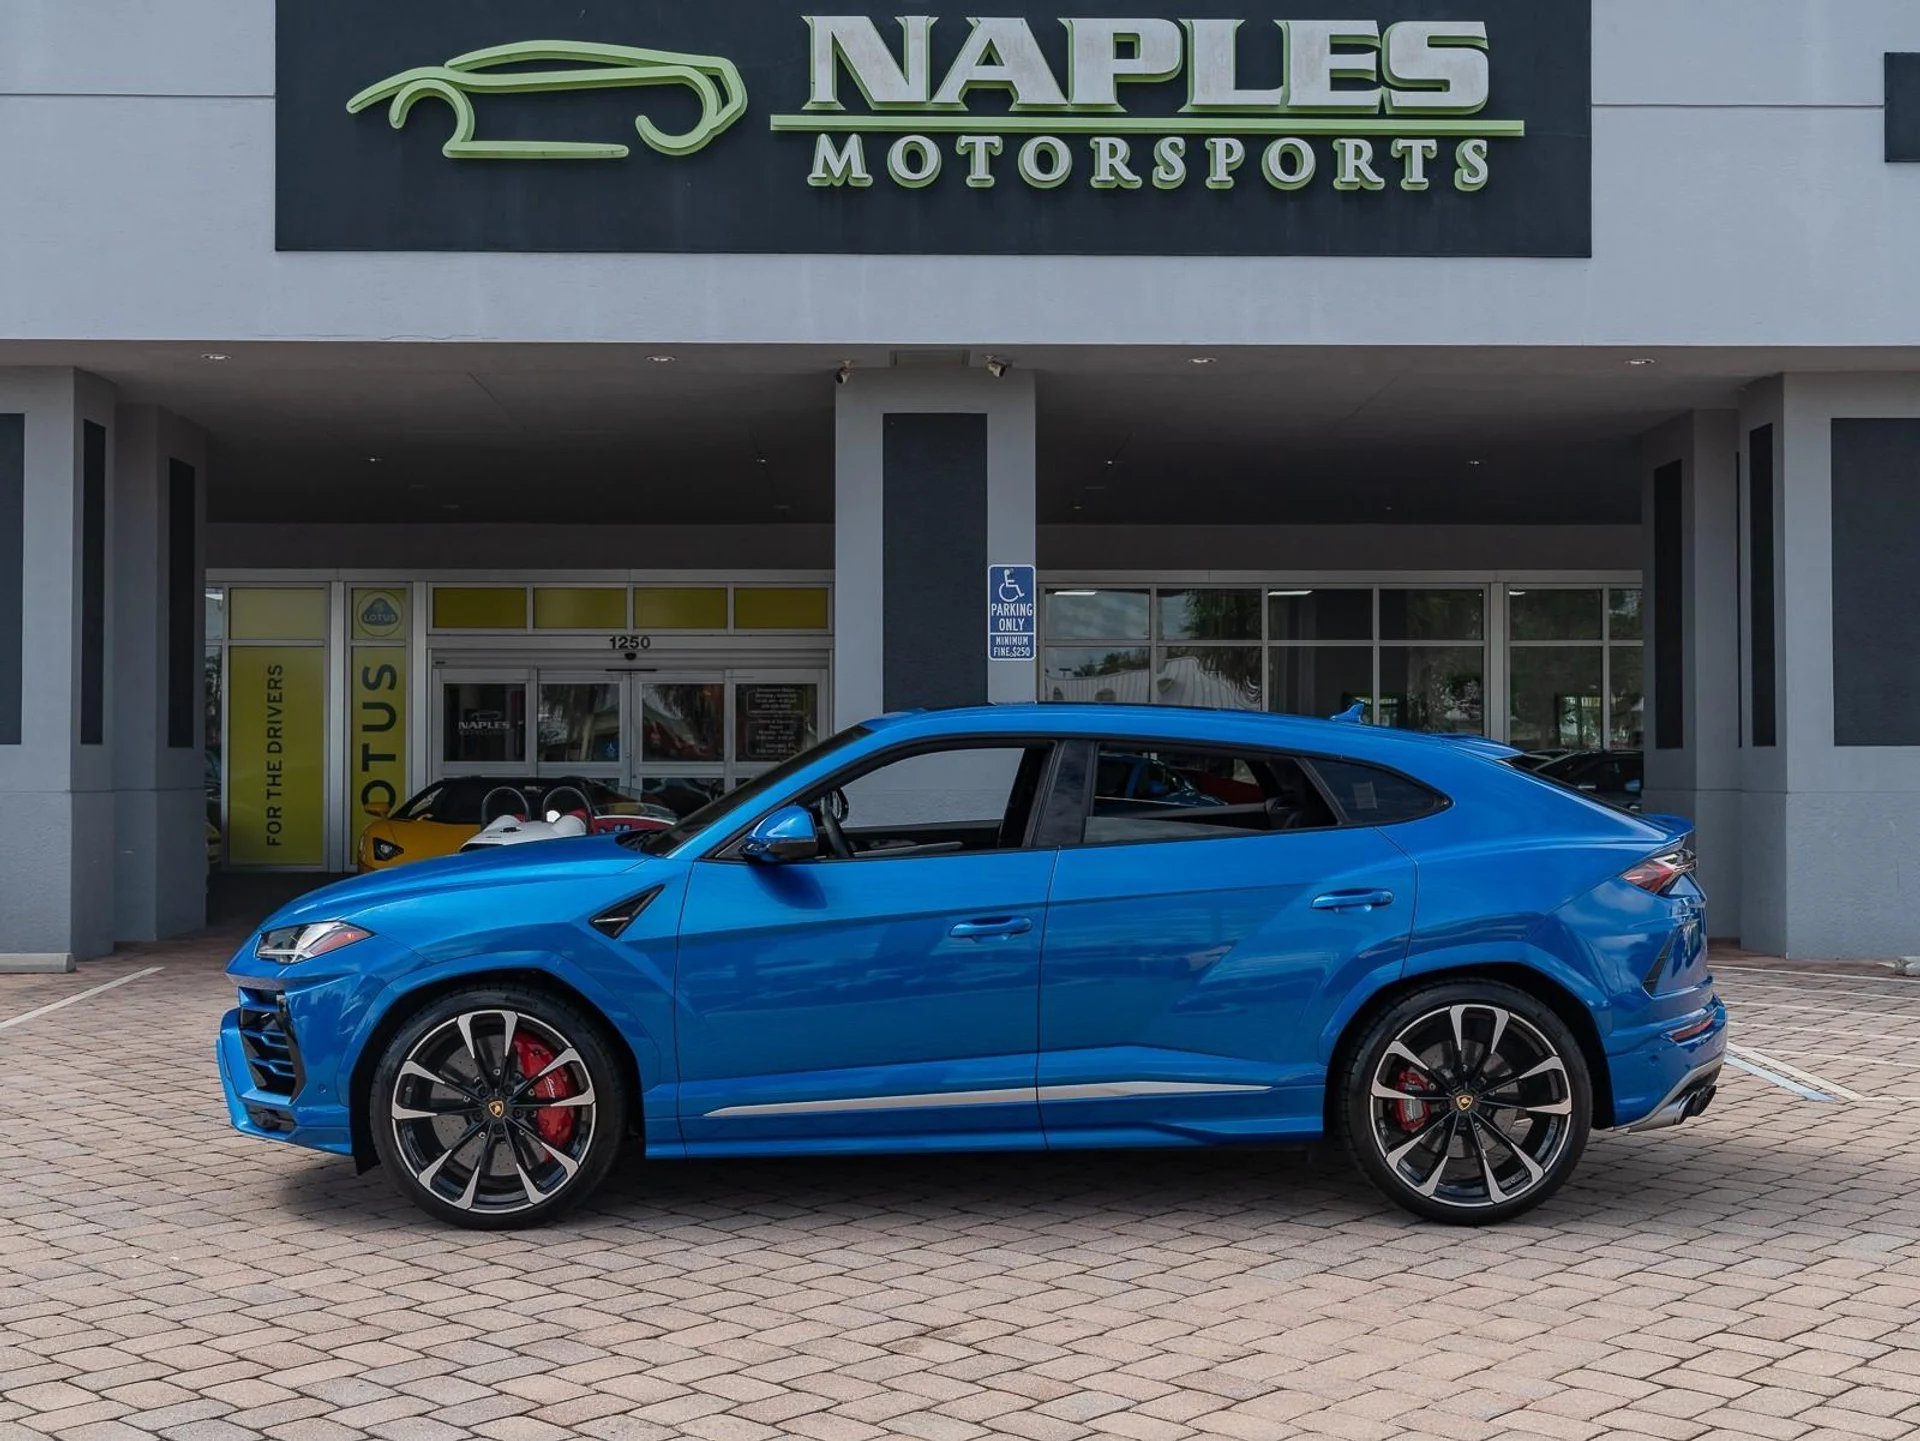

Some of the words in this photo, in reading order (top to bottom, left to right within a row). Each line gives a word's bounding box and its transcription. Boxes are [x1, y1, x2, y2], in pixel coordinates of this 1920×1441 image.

[802, 15, 1489, 115] NAPLES
[807, 133, 1489, 190] MOTORSPORTS
[991, 603, 1033, 616] PARKING
[364, 614, 396, 622] LOTUS
[999, 618, 1025, 631] ONLY
[609, 636, 651, 649] 1250
[996, 636, 1029, 645] MINIMUM
[993, 647, 1010, 656] FINE
[266, 664, 283, 754] DRIVERS
[458, 721, 510, 729] NAPLES
[361, 664, 397, 807] OTUS
[266, 760, 283, 800] THE
[266, 806, 283, 846] FOR
